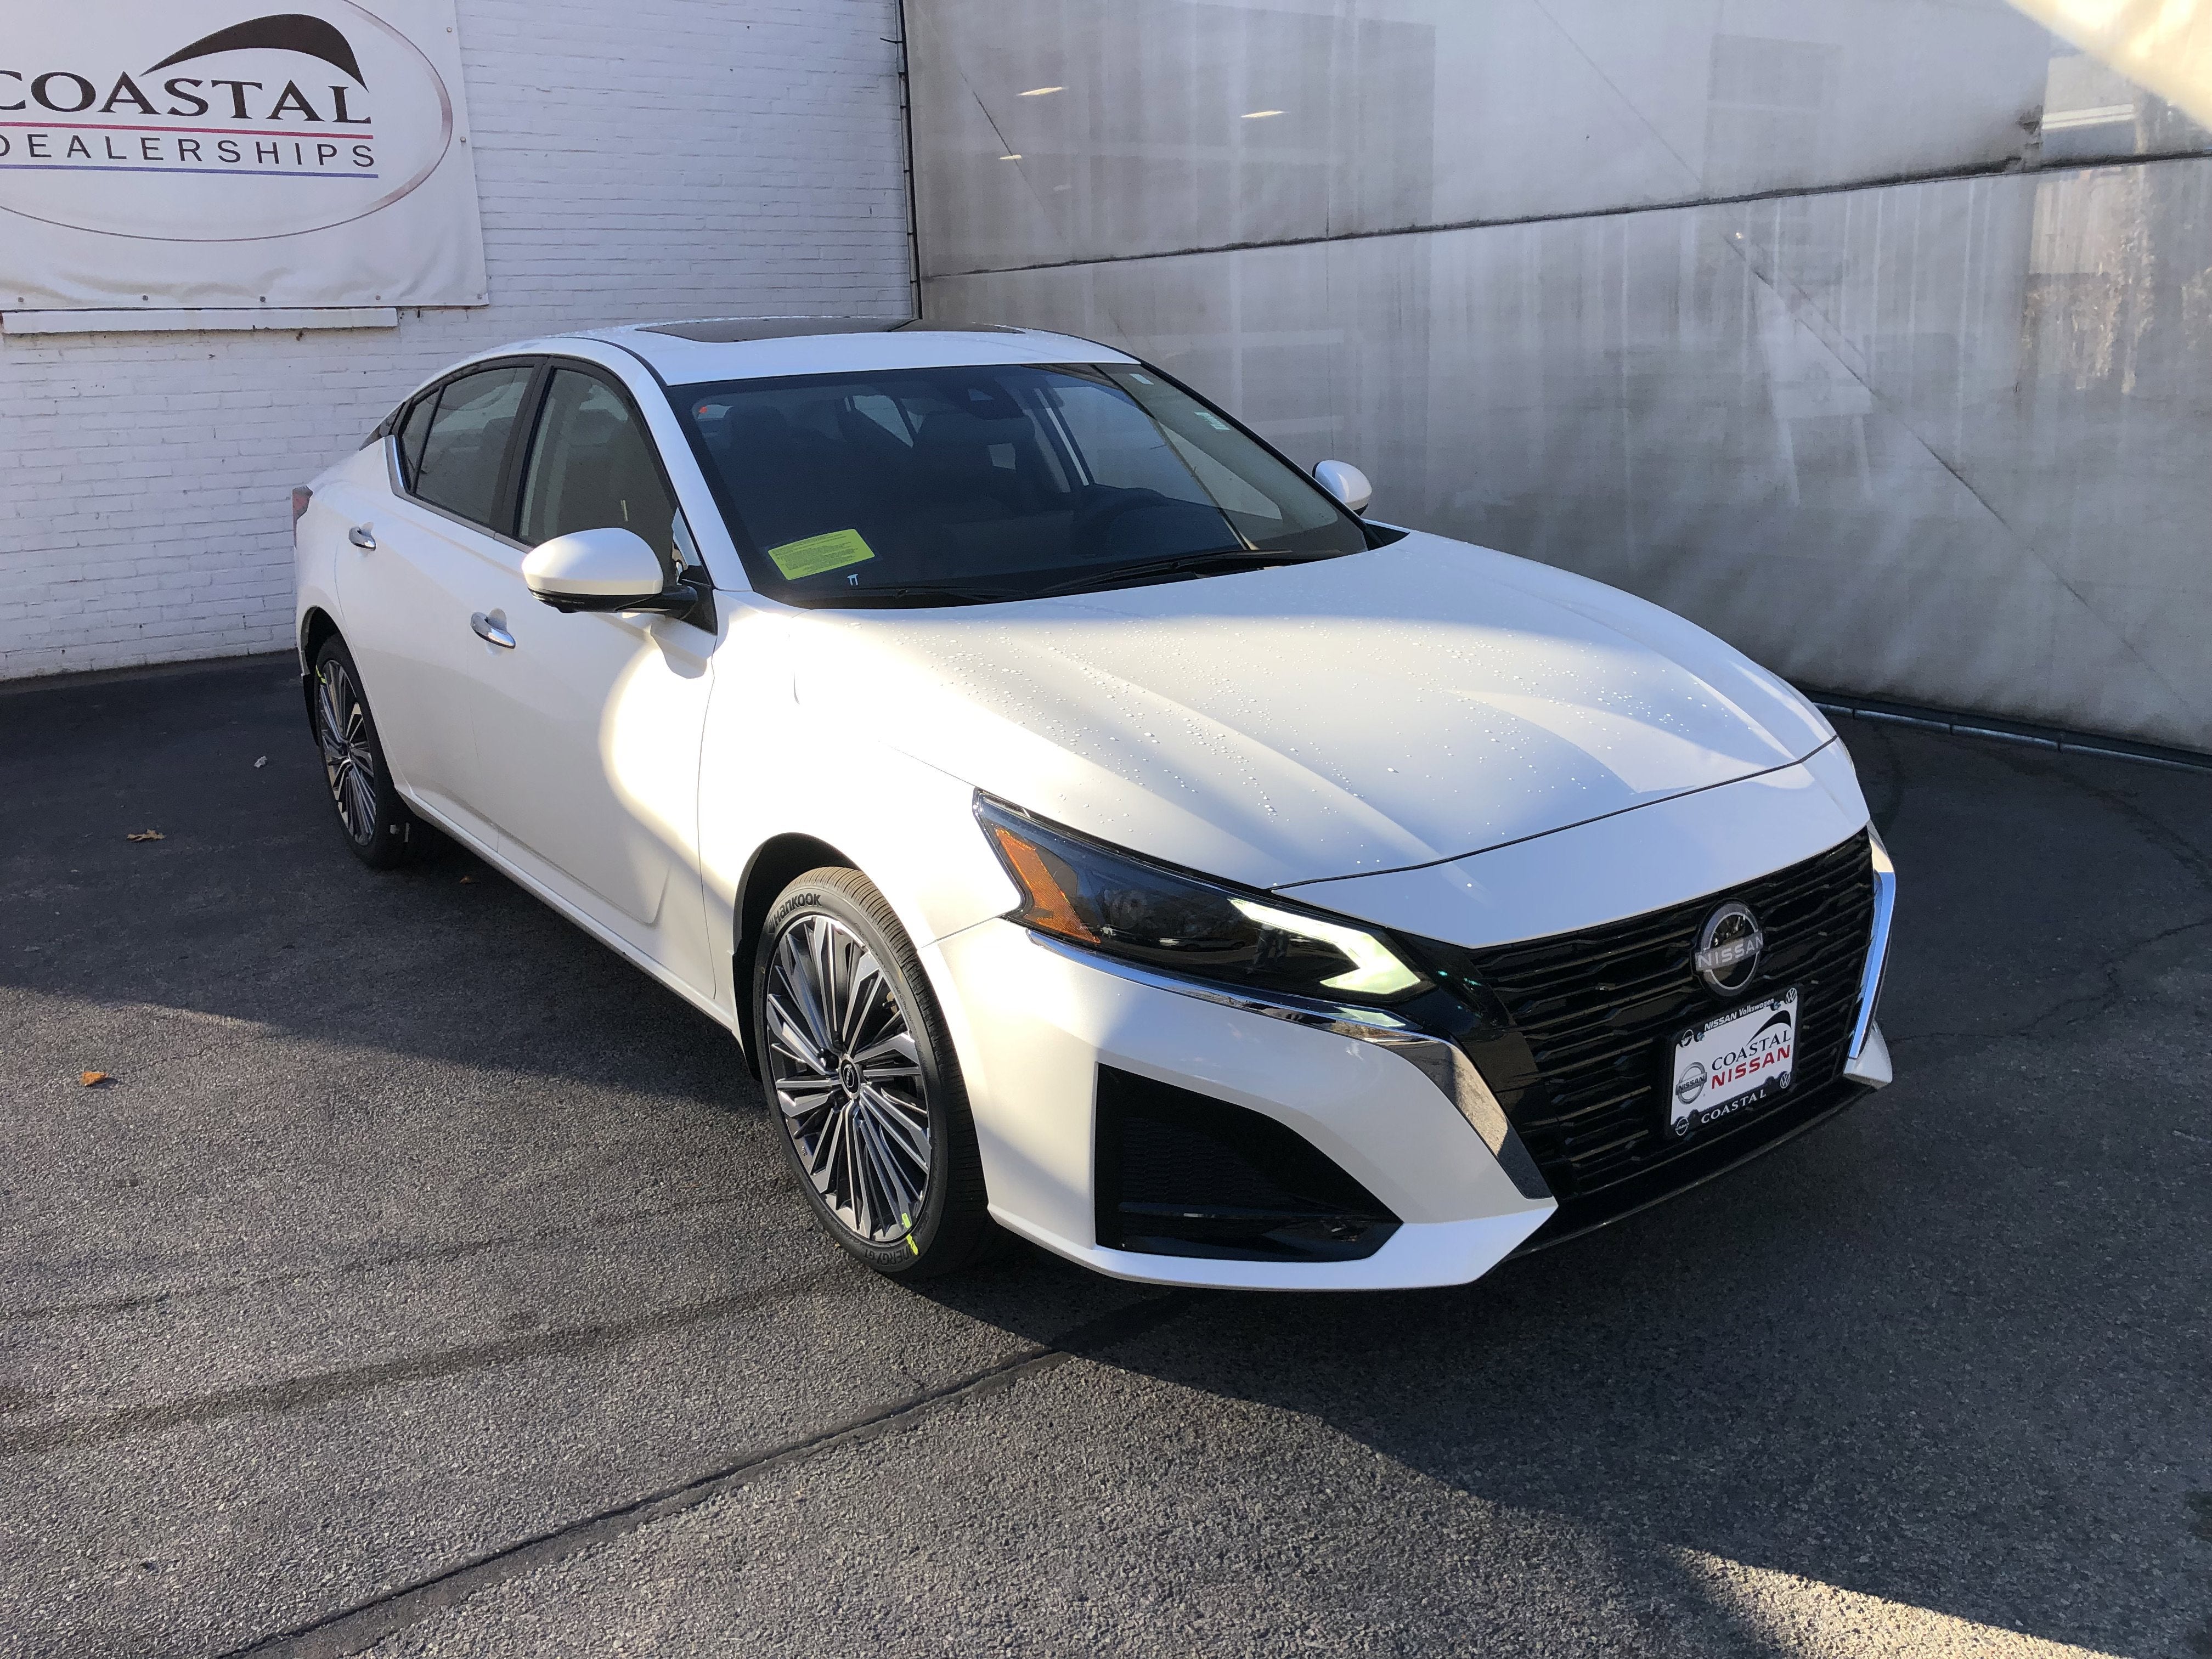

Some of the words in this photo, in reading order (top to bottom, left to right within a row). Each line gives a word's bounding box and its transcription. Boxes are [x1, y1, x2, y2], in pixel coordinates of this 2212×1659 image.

[1696, 933, 1763, 968] NISSAN
[1704, 1011, 1737, 1031] NISSAN
[1739, 998, 1774, 1017] Volkswagen
[1711, 1044, 1791, 1090] NISSAN
[1712, 1030, 1791, 1071] COASTAL
[1678, 1075, 1705, 1090] NISSAN
[1701, 1089, 1767, 1124] COASTAL
